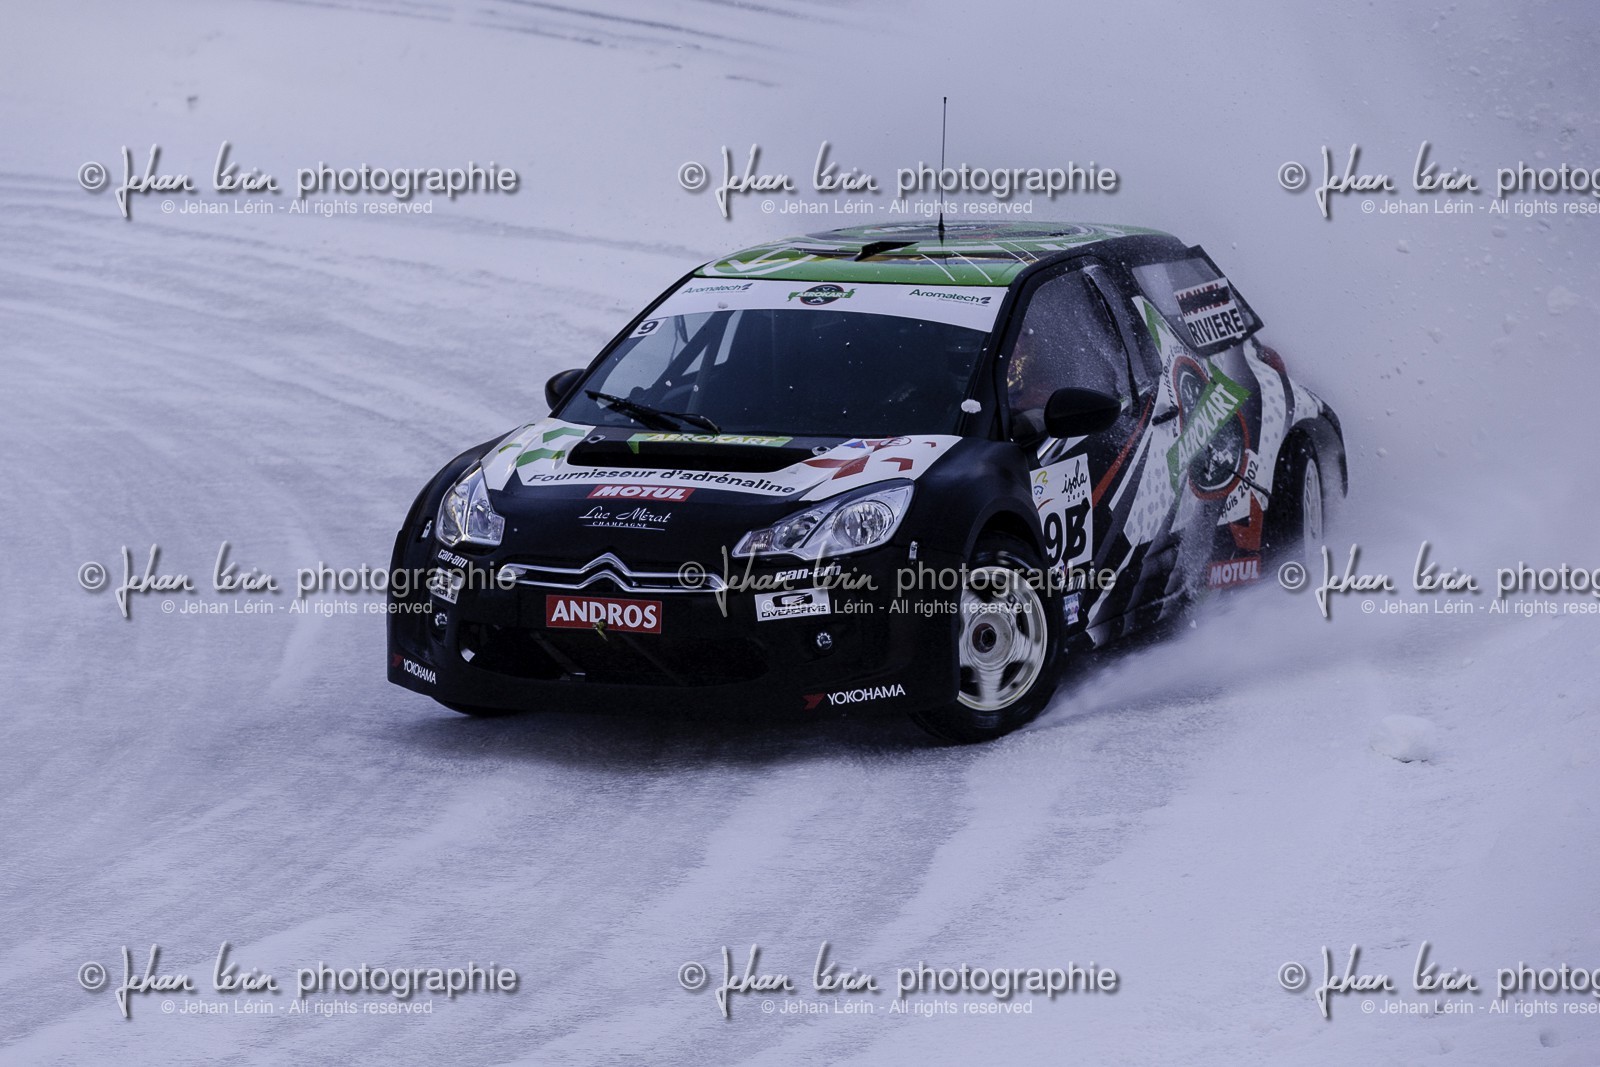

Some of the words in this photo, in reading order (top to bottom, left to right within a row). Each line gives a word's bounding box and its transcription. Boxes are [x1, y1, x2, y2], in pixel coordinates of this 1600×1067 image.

[909, 289, 980, 302] Aromatech
[637, 320, 660, 335] 9
[1187, 308, 1244, 346] RIVIERE
[1178, 383, 1239, 466] AEROKART
[646, 433, 777, 446] AEROKART
[527, 468, 656, 483] Fournisseur
[660, 469, 796, 494] d'adrénaline
[1062, 460, 1088, 494] isola
[596, 485, 687, 500] MOTUL
[578, 505, 611, 520] Luc
[437, 549, 468, 569] can-am
[775, 564, 842, 583] can-am
[1210, 561, 1259, 585] MOTUL
[551, 599, 658, 629] ANDROS
[403, 658, 437, 685] YOKOHAMA
[827, 684, 906, 706] YOKOHAMA
